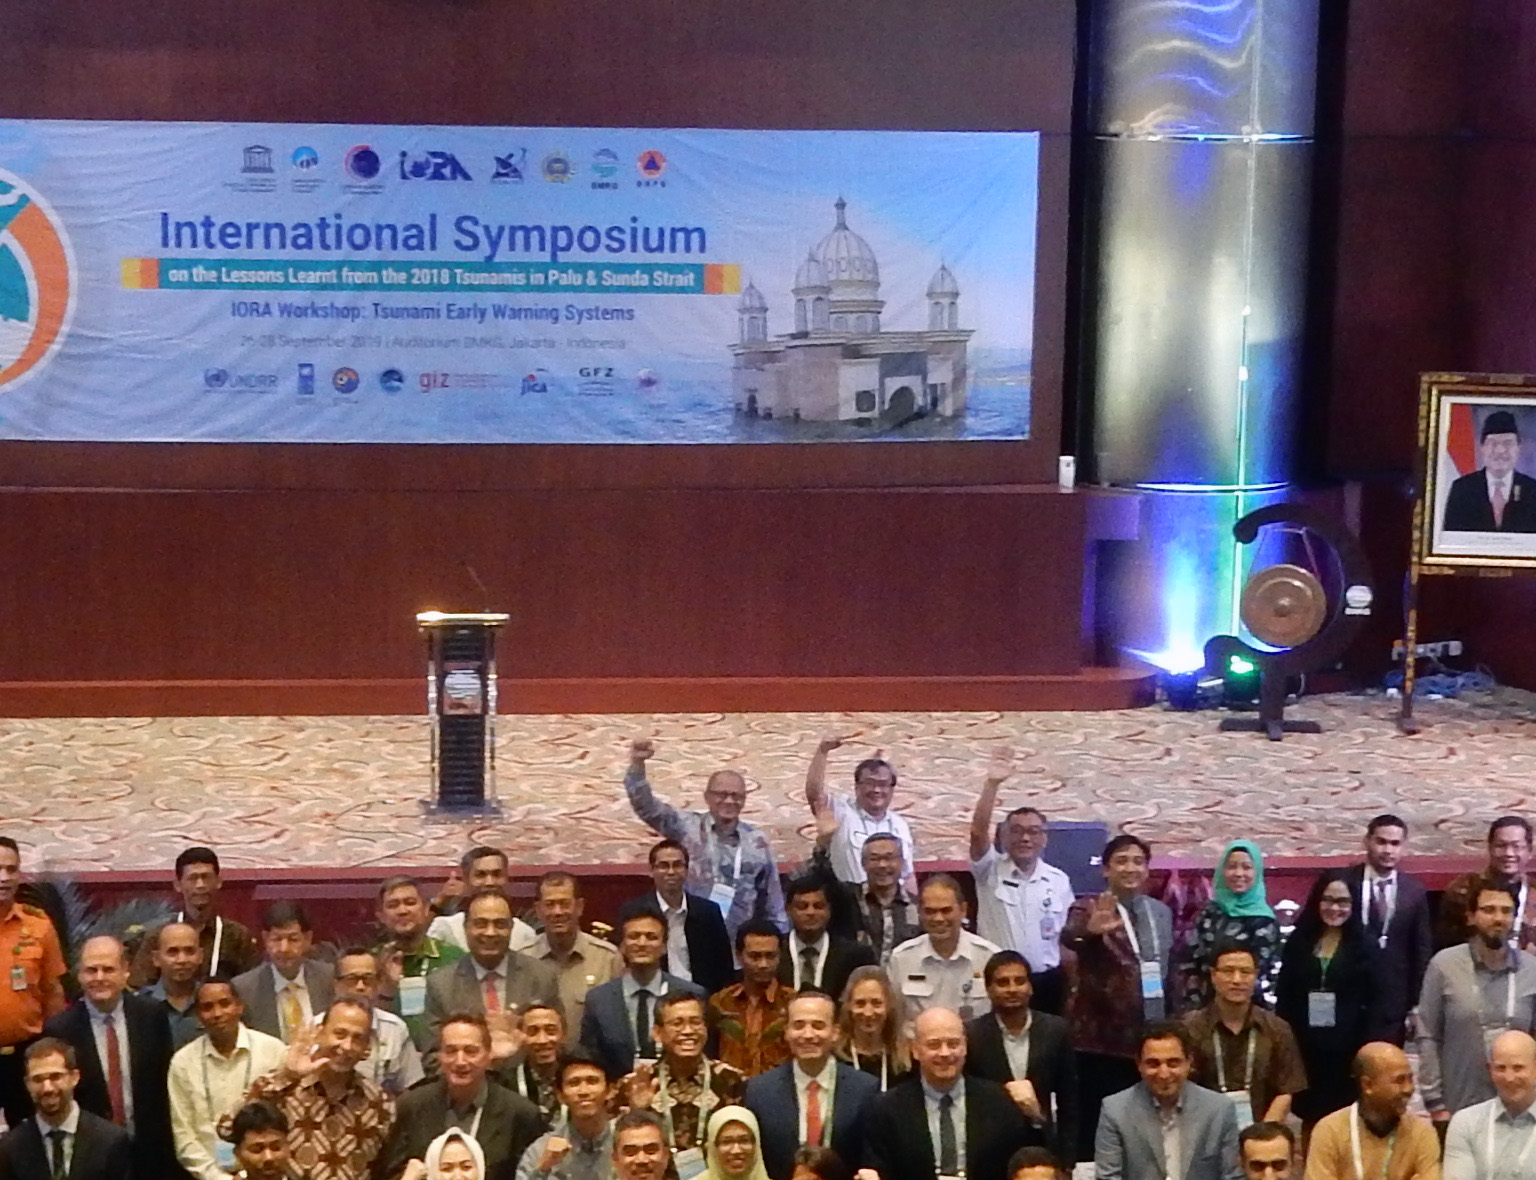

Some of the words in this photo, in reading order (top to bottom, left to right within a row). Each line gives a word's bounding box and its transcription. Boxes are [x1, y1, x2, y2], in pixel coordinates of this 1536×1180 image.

[161, 212, 437, 250] International
[454, 215, 706, 262] Symposium
[168, 269, 189, 282] on
[192, 266, 217, 282] the
[221, 266, 284, 283] Lessons
[288, 267, 337, 284] Learnt
[342, 267, 378, 284] from
[381, 267, 407, 284] the
[411, 267, 450, 284] 2018
[454, 269, 526, 285] Tsunamis
[529, 269, 545, 285] in
[548, 269, 583, 286] Palu
[586, 269, 597, 286] &
[601, 270, 649, 286] Sunda
[653, 271, 695, 287] Strait
[231, 301, 272, 318] IORA
[277, 301, 366, 323] Workshop:
[372, 302, 441, 319] Tsunami
[446, 303, 487, 324] Early
[491, 303, 560, 325] Warning
[564, 304, 635, 325] Systems
[579, 367, 613, 378] GFZ
